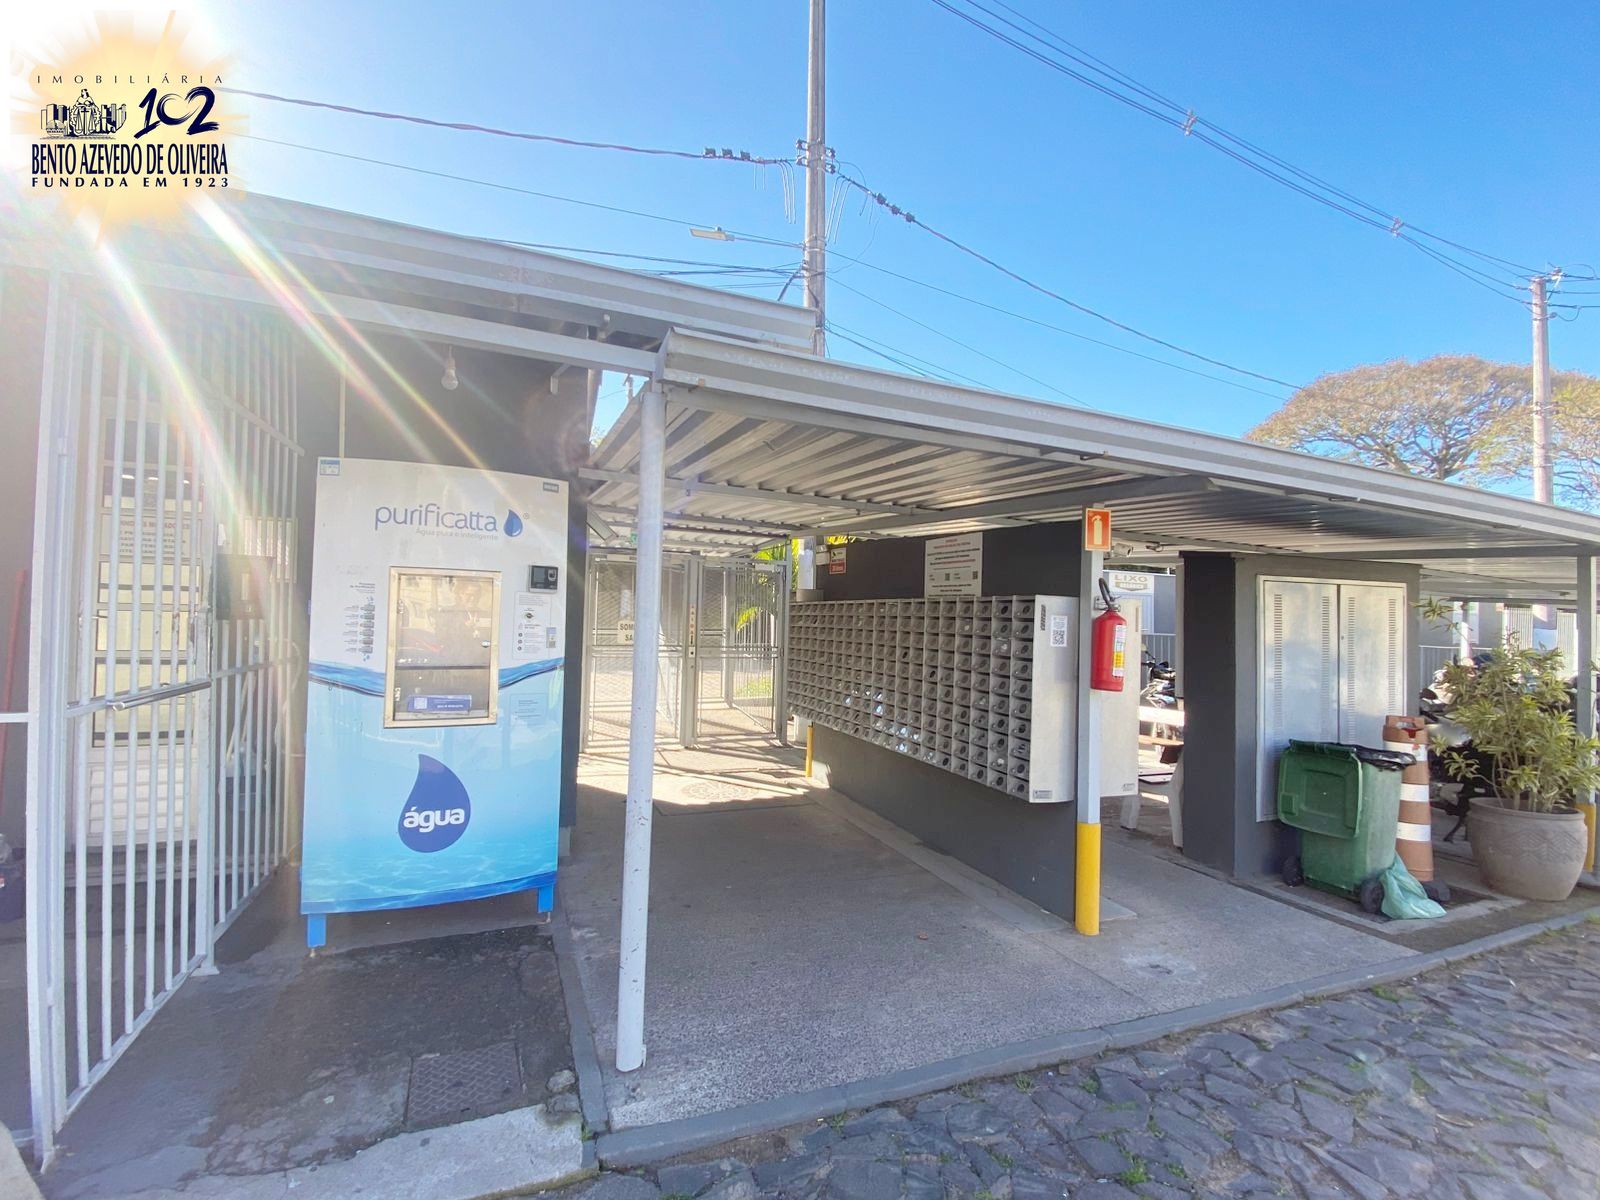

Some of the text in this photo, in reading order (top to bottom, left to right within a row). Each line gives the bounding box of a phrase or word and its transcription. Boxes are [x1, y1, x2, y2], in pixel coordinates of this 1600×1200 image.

[374, 503, 498, 532] purificatta
[1115, 574, 1148, 583] LIXO
[619, 623, 635, 631] SOM
[403, 806, 465, 833] água
